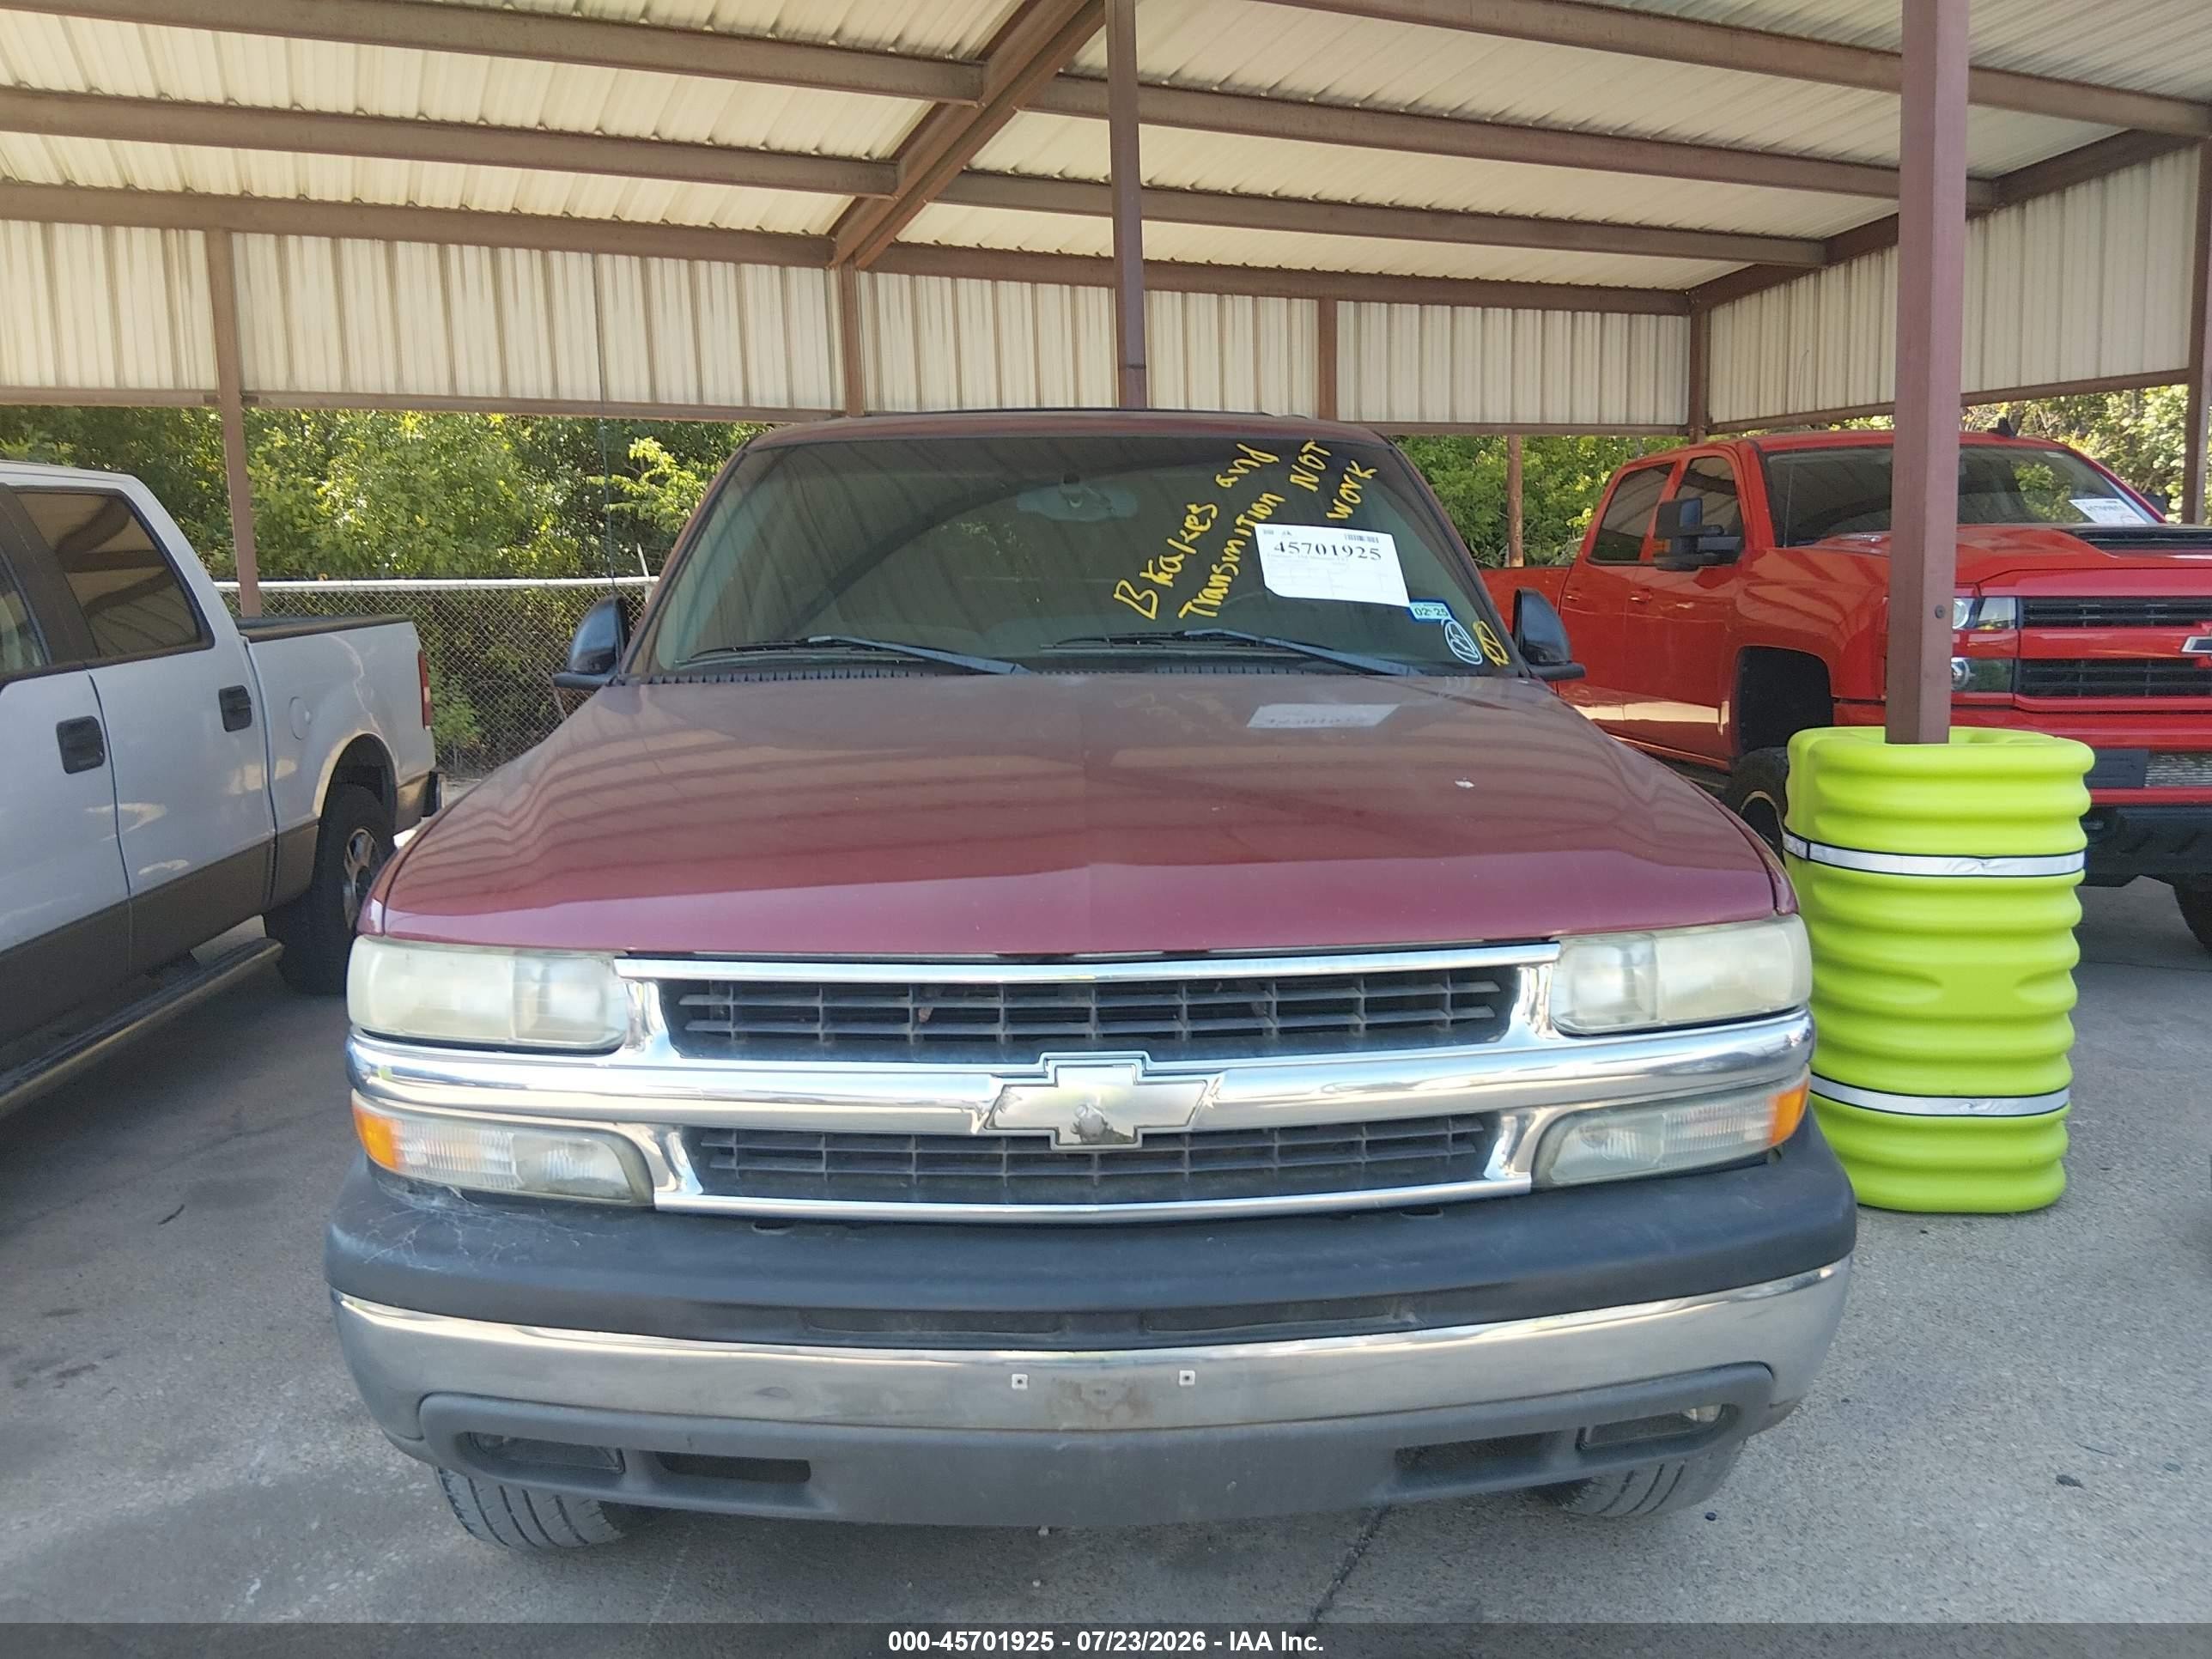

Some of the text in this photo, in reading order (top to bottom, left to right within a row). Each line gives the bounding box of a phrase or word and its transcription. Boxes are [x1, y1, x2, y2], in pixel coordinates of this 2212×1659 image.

[1290, 439, 1332, 492] NOT
[1113, 441, 1279, 620] Brakes and
[1273, 541, 1382, 561] 45701925
